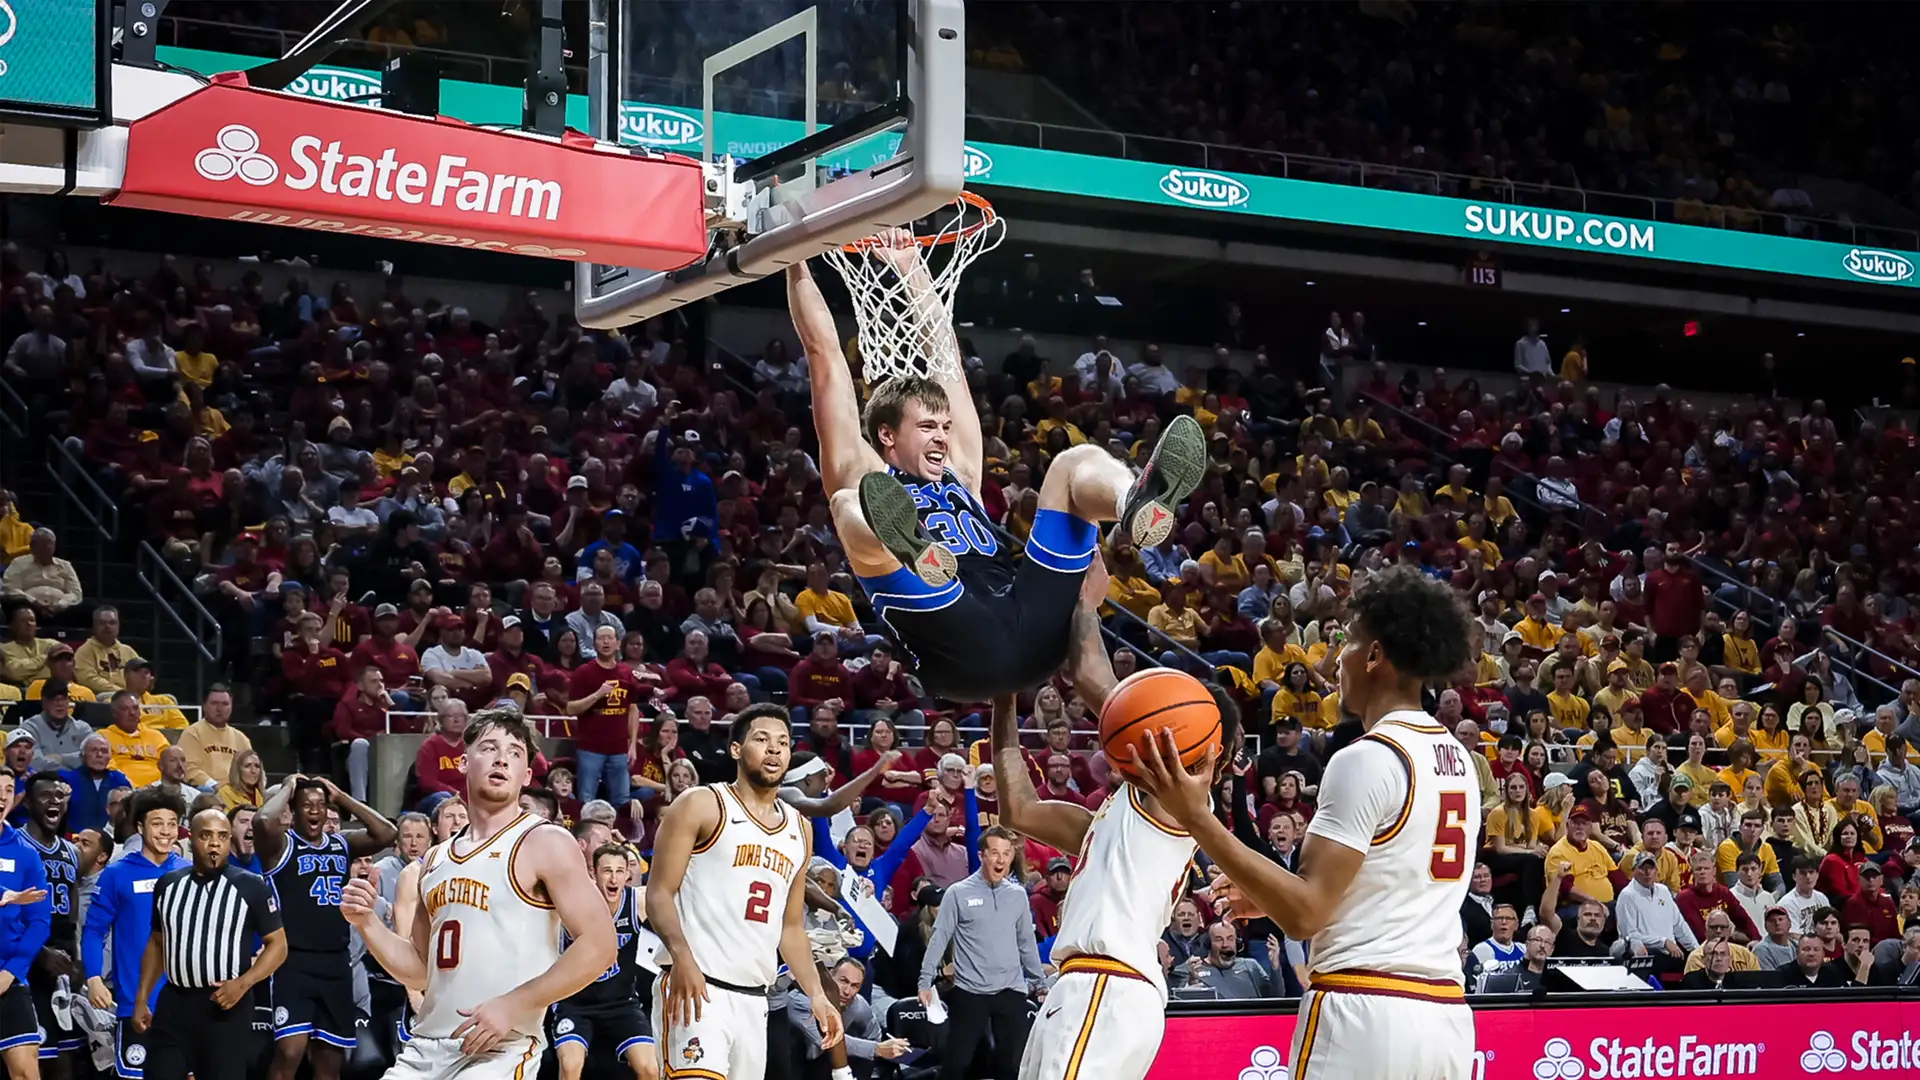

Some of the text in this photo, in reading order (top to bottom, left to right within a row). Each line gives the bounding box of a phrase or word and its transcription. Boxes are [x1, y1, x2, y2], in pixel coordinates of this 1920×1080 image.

[1168, 169, 1241, 206] Sukup
[1465, 205, 1654, 252] SUKUP.COM
[1472, 267, 1496, 285] 113
[1849, 248, 1907, 280] Sukup
[924, 510, 998, 557] 30
[1433, 743, 1466, 777] JONES
[1428, 791, 1466, 881] 5
[296, 853, 348, 875] BYU
[732, 843, 795, 884] IOWA STATE
[309, 875, 343, 906] 45
[449, 877, 490, 912] STATE
[745, 880, 772, 923] 2
[437, 919, 462, 977] 0
